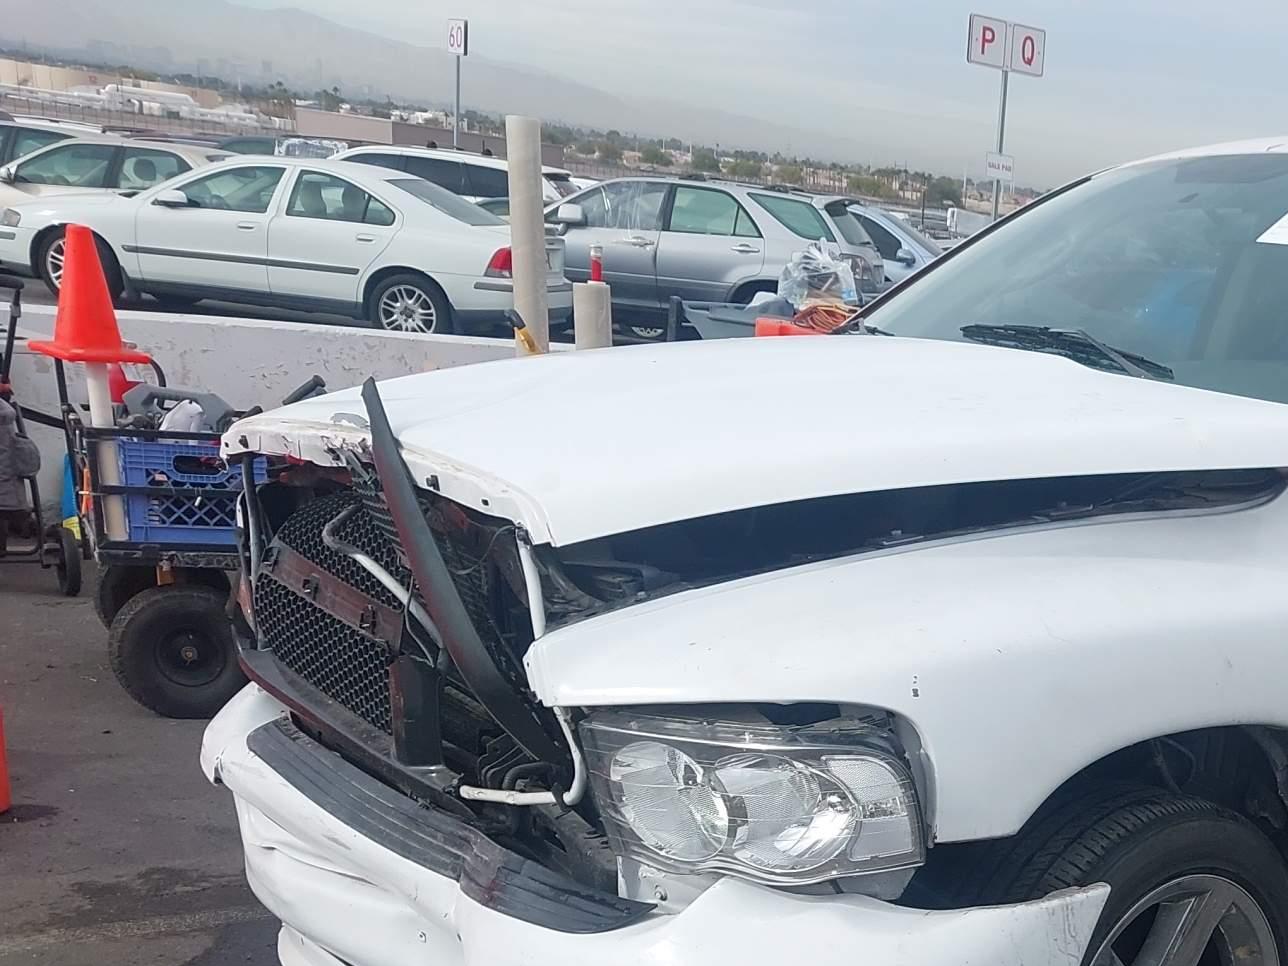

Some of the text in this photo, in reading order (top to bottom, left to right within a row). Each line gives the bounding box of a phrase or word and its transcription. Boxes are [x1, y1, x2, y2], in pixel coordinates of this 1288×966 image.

[449, 25, 463, 48] 60
[981, 25, 996, 55] P
[1021, 35, 1035, 67] Q
